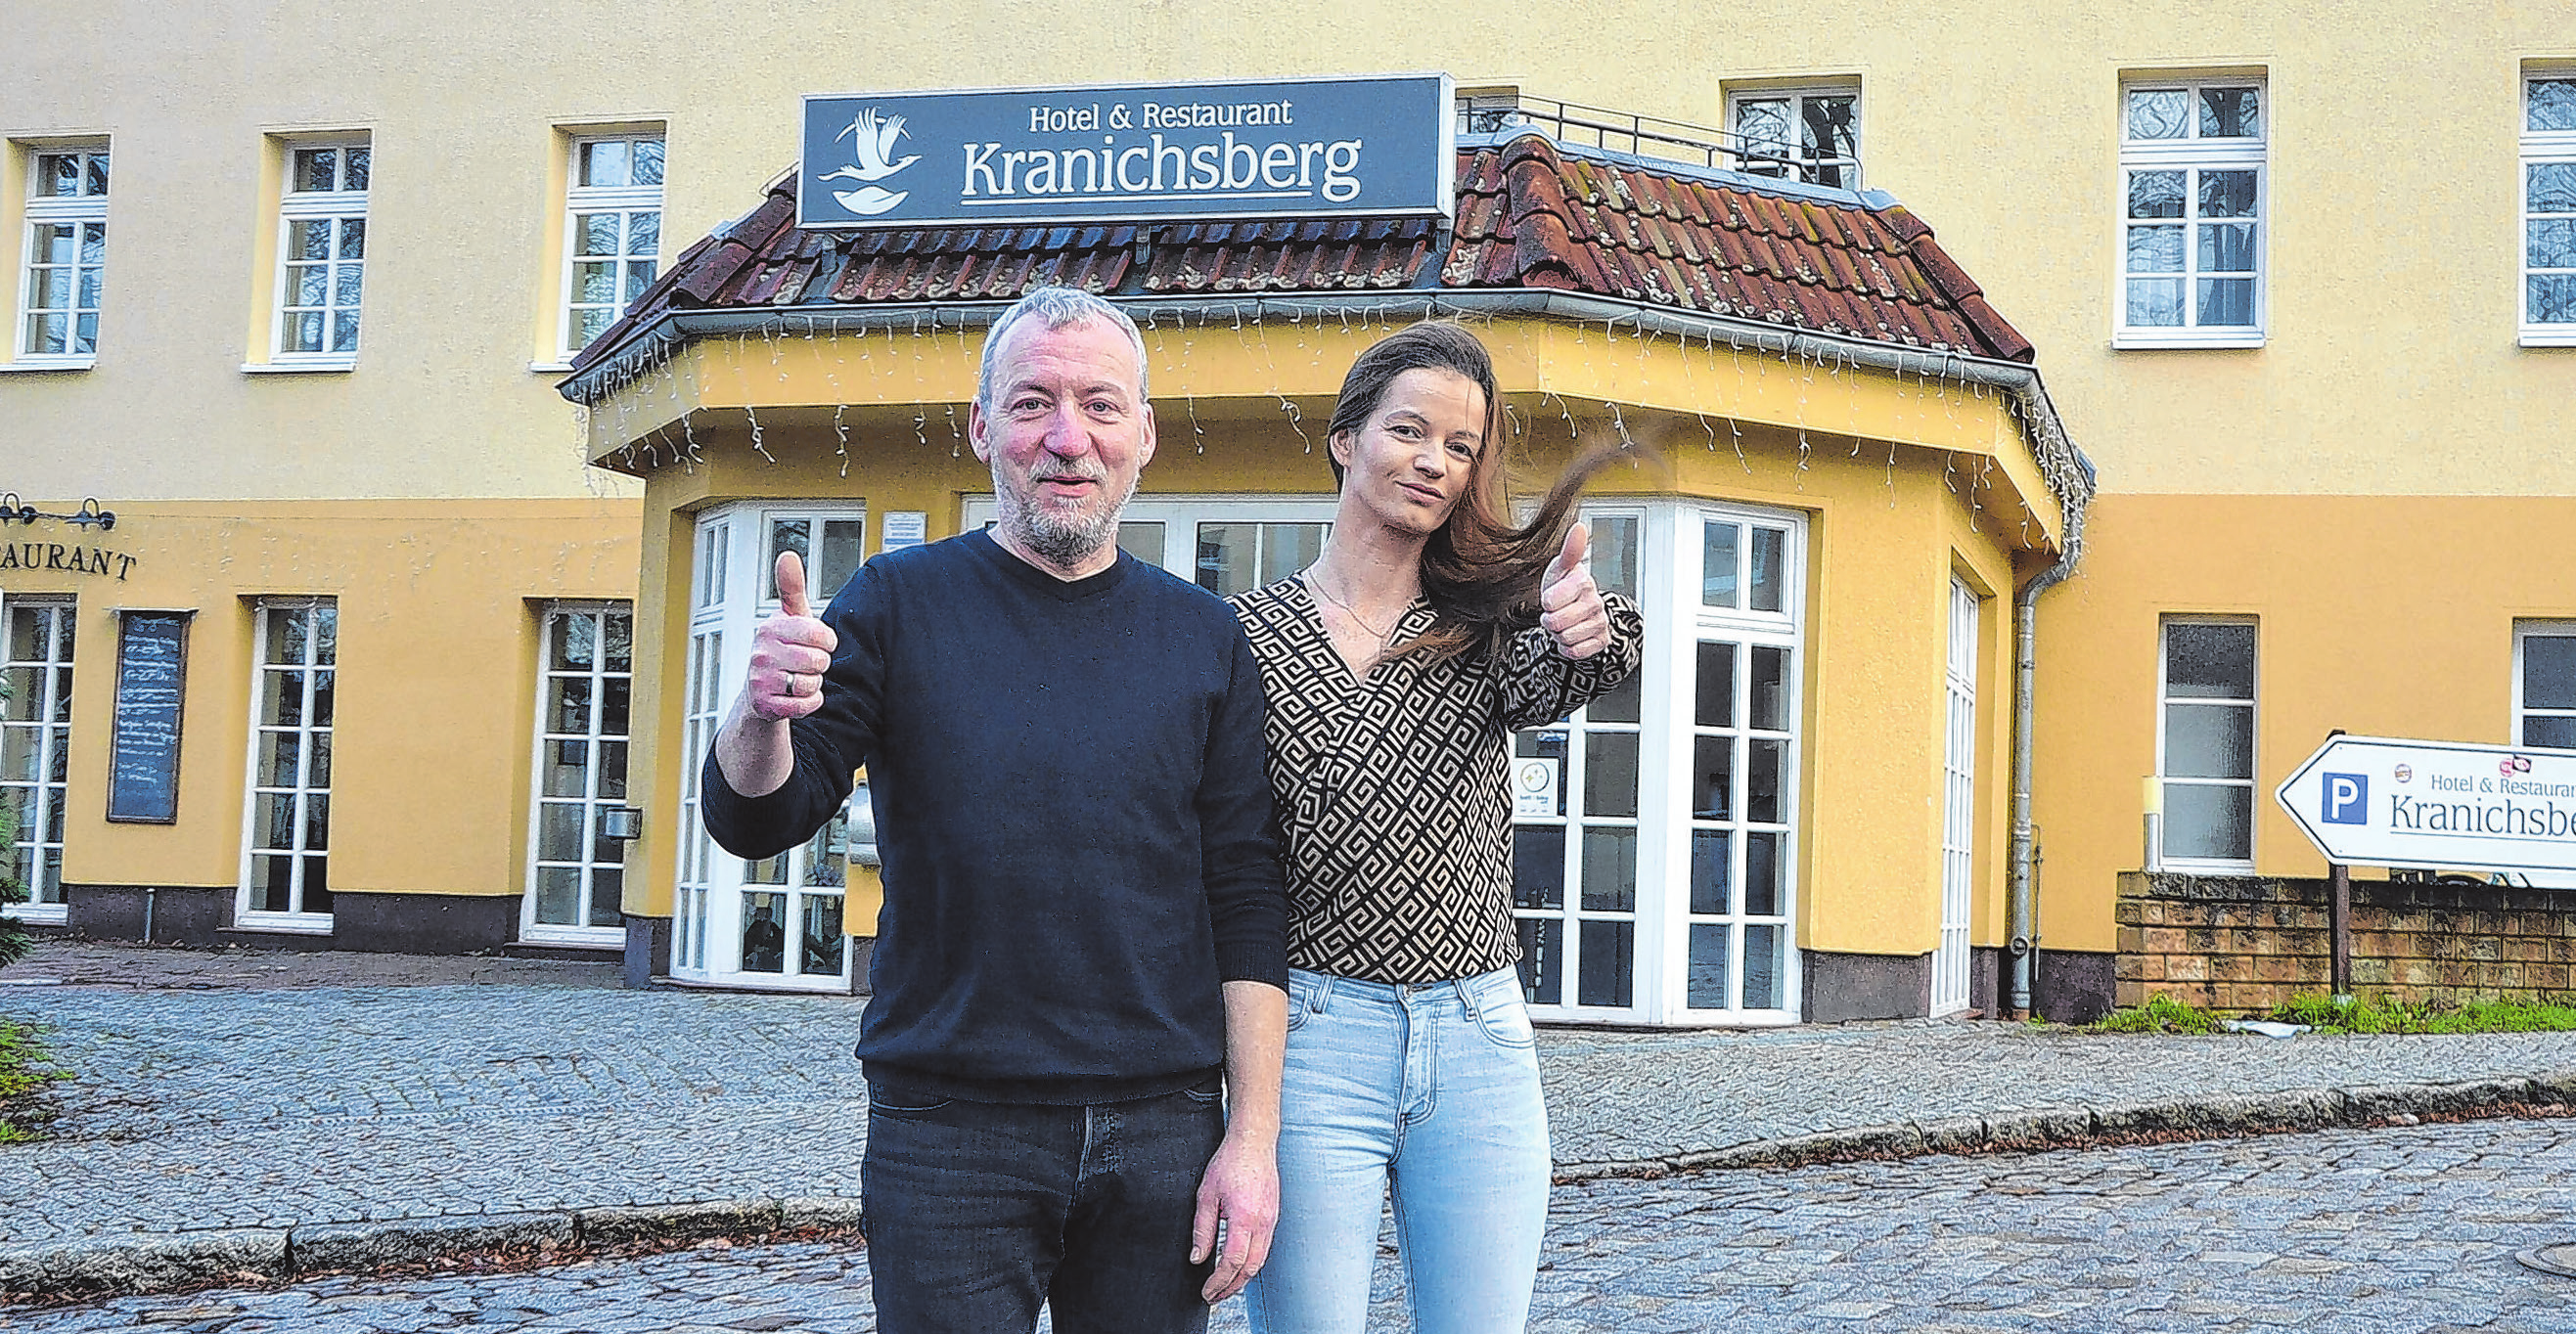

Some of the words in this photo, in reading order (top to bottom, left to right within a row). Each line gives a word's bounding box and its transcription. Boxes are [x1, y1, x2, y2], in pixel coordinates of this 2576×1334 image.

[1028, 103, 1100, 133] Hotel
[1107, 104, 1133, 130] &
[1142, 99, 1293, 129] Restaurant
[960, 132, 1363, 202] Kranichsberg
[0, 542, 137, 581] AURANT
[2330, 778, 2360, 821] P
[2430, 774, 2473, 792] Hotel
[2479, 777, 2494, 793] &
